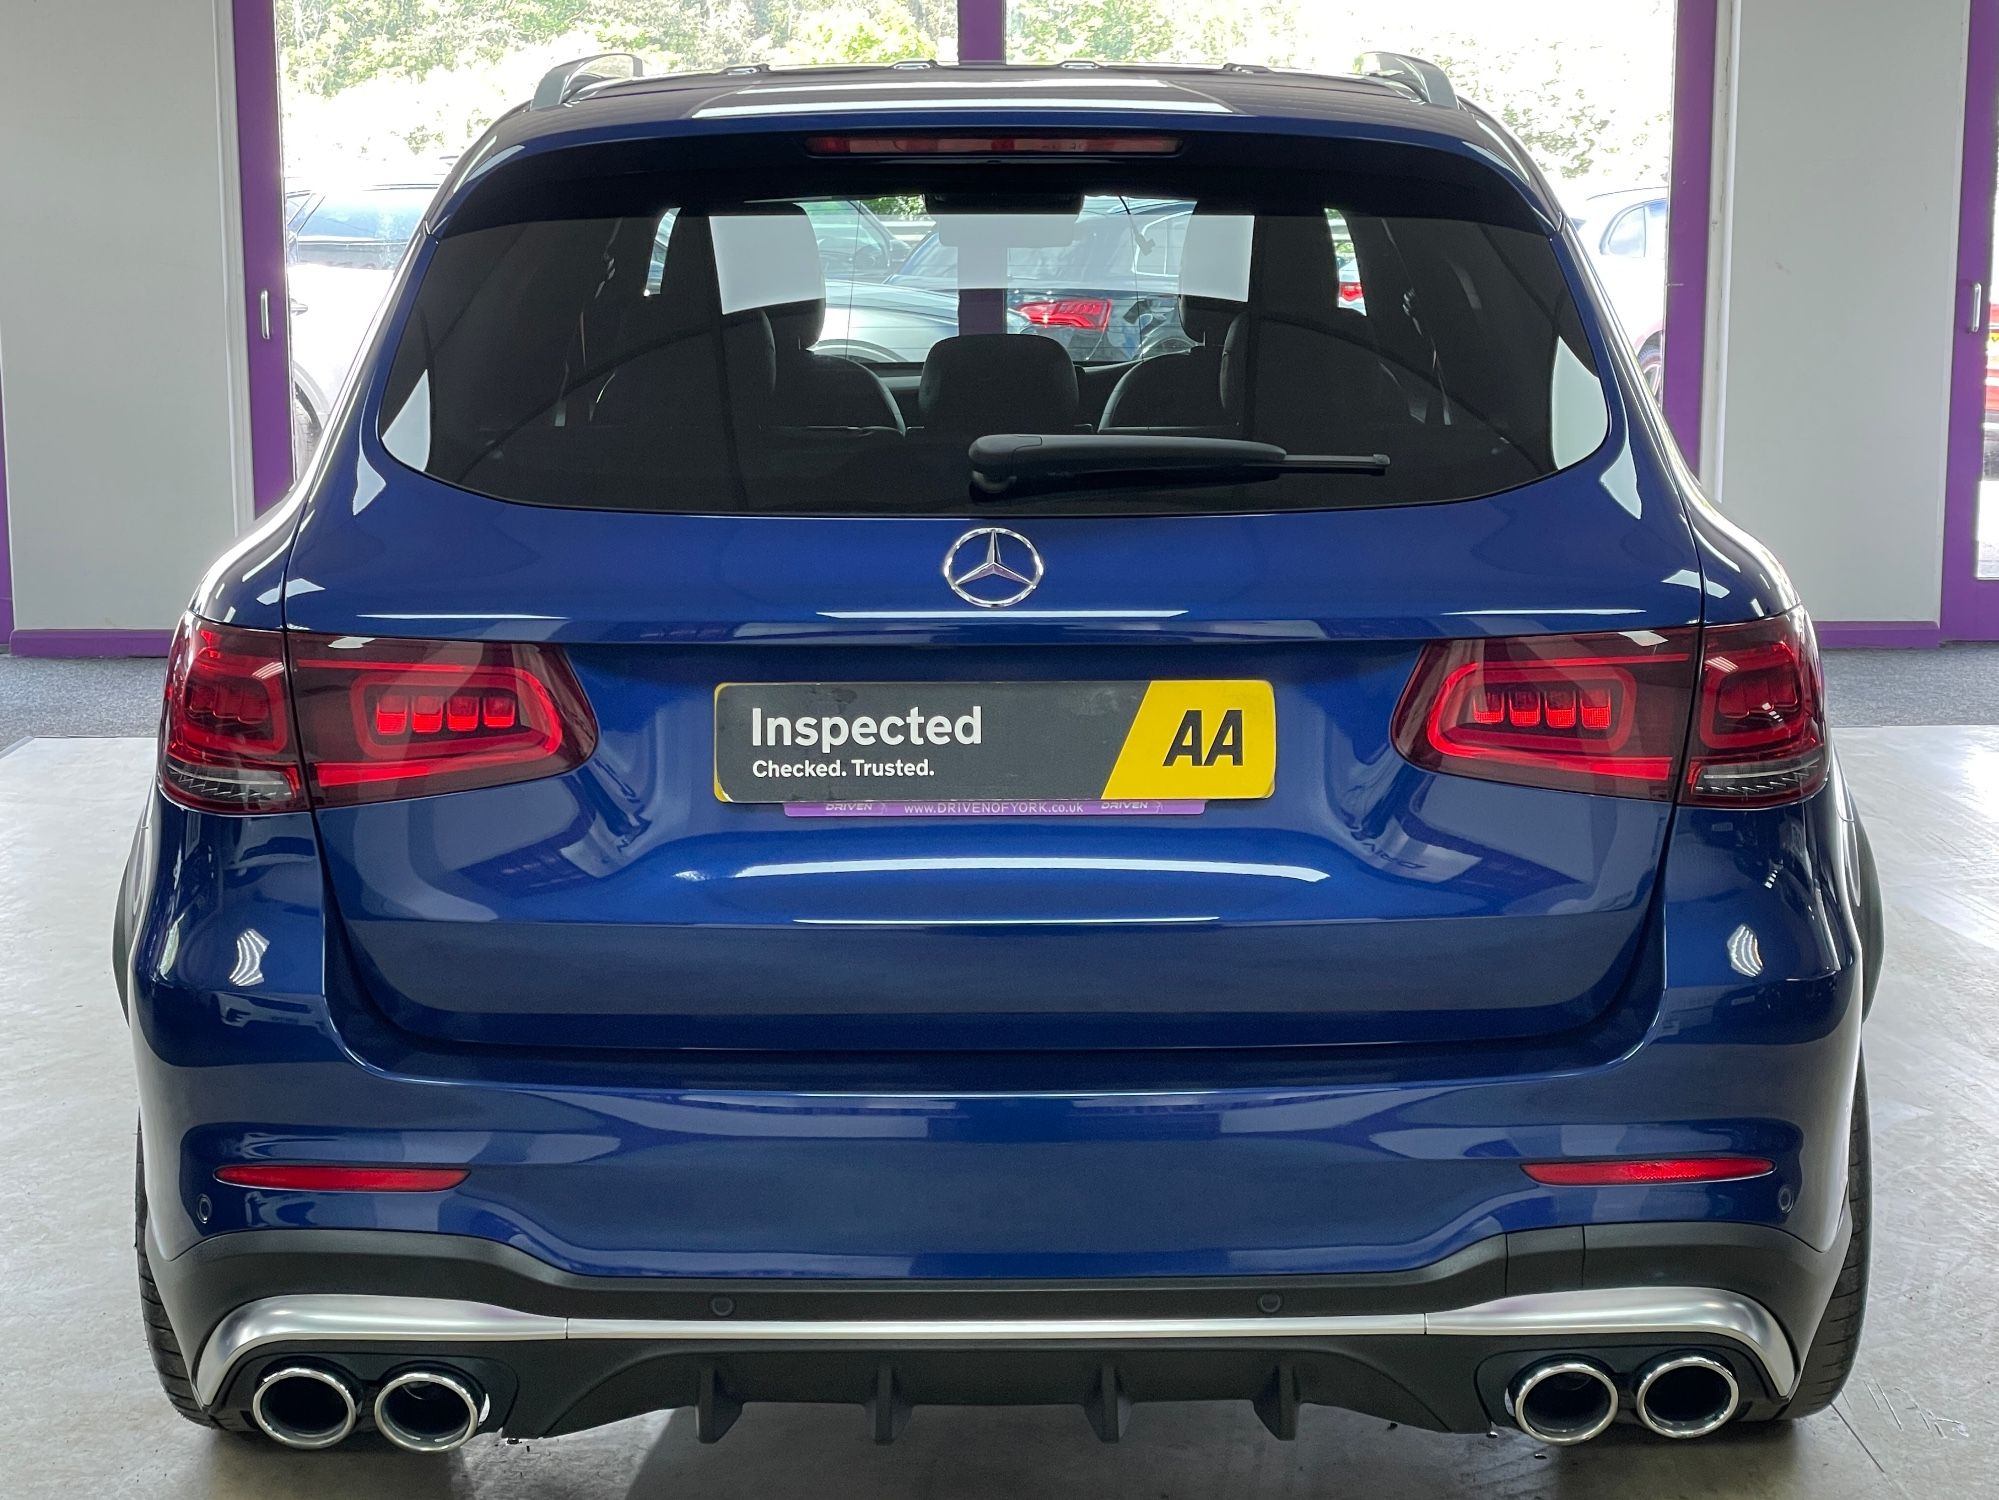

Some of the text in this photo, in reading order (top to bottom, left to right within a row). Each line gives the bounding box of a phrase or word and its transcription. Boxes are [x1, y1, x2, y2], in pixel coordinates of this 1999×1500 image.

[752, 706, 982, 753] Inspected
[1163, 710, 1243, 766] AA
[752, 759, 935, 778] Checked. Trusted.
[825, 802, 872, 811] DRIVEN
[904, 801, 1084, 814] www.DRIVENOFYORK.co.uk
[1101, 801, 1148, 810] DRIVEN
